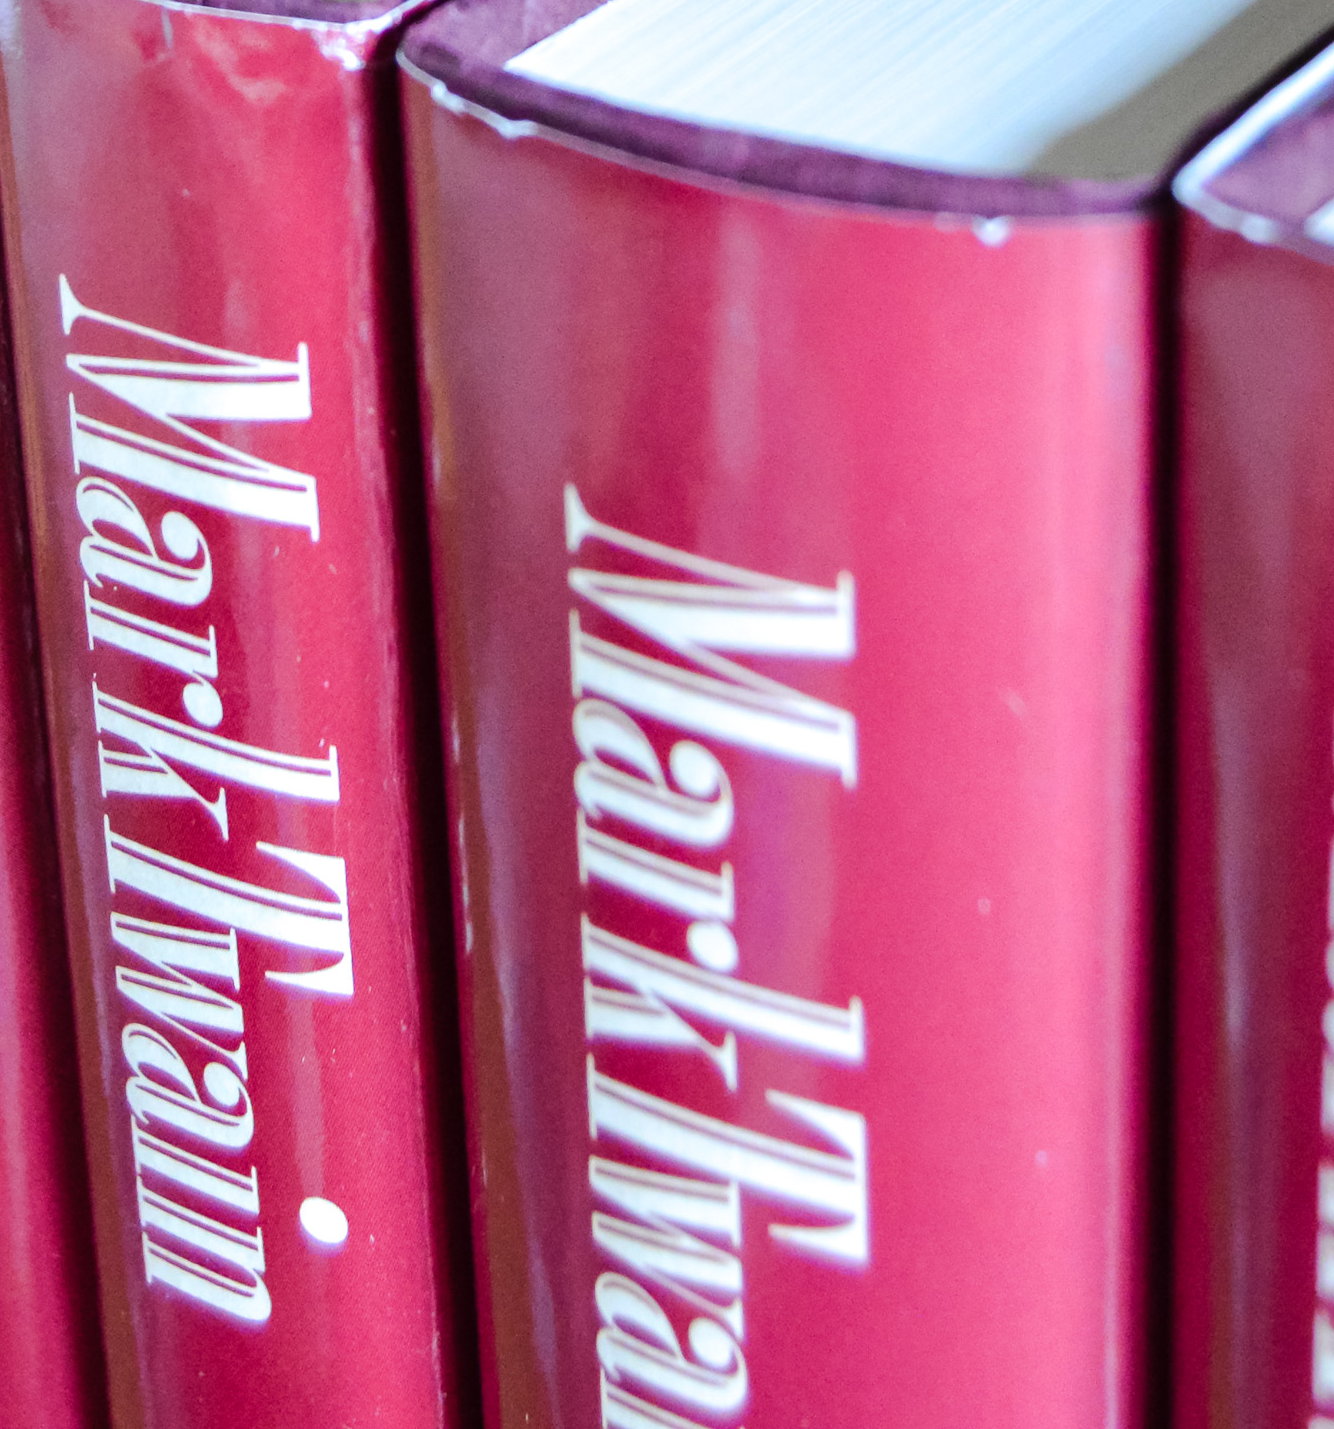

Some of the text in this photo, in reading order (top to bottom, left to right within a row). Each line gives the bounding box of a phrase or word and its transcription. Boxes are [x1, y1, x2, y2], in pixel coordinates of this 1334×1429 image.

[59, 274, 355, 1324] Mark Twain
[565, 483, 867, 1093] Mark
